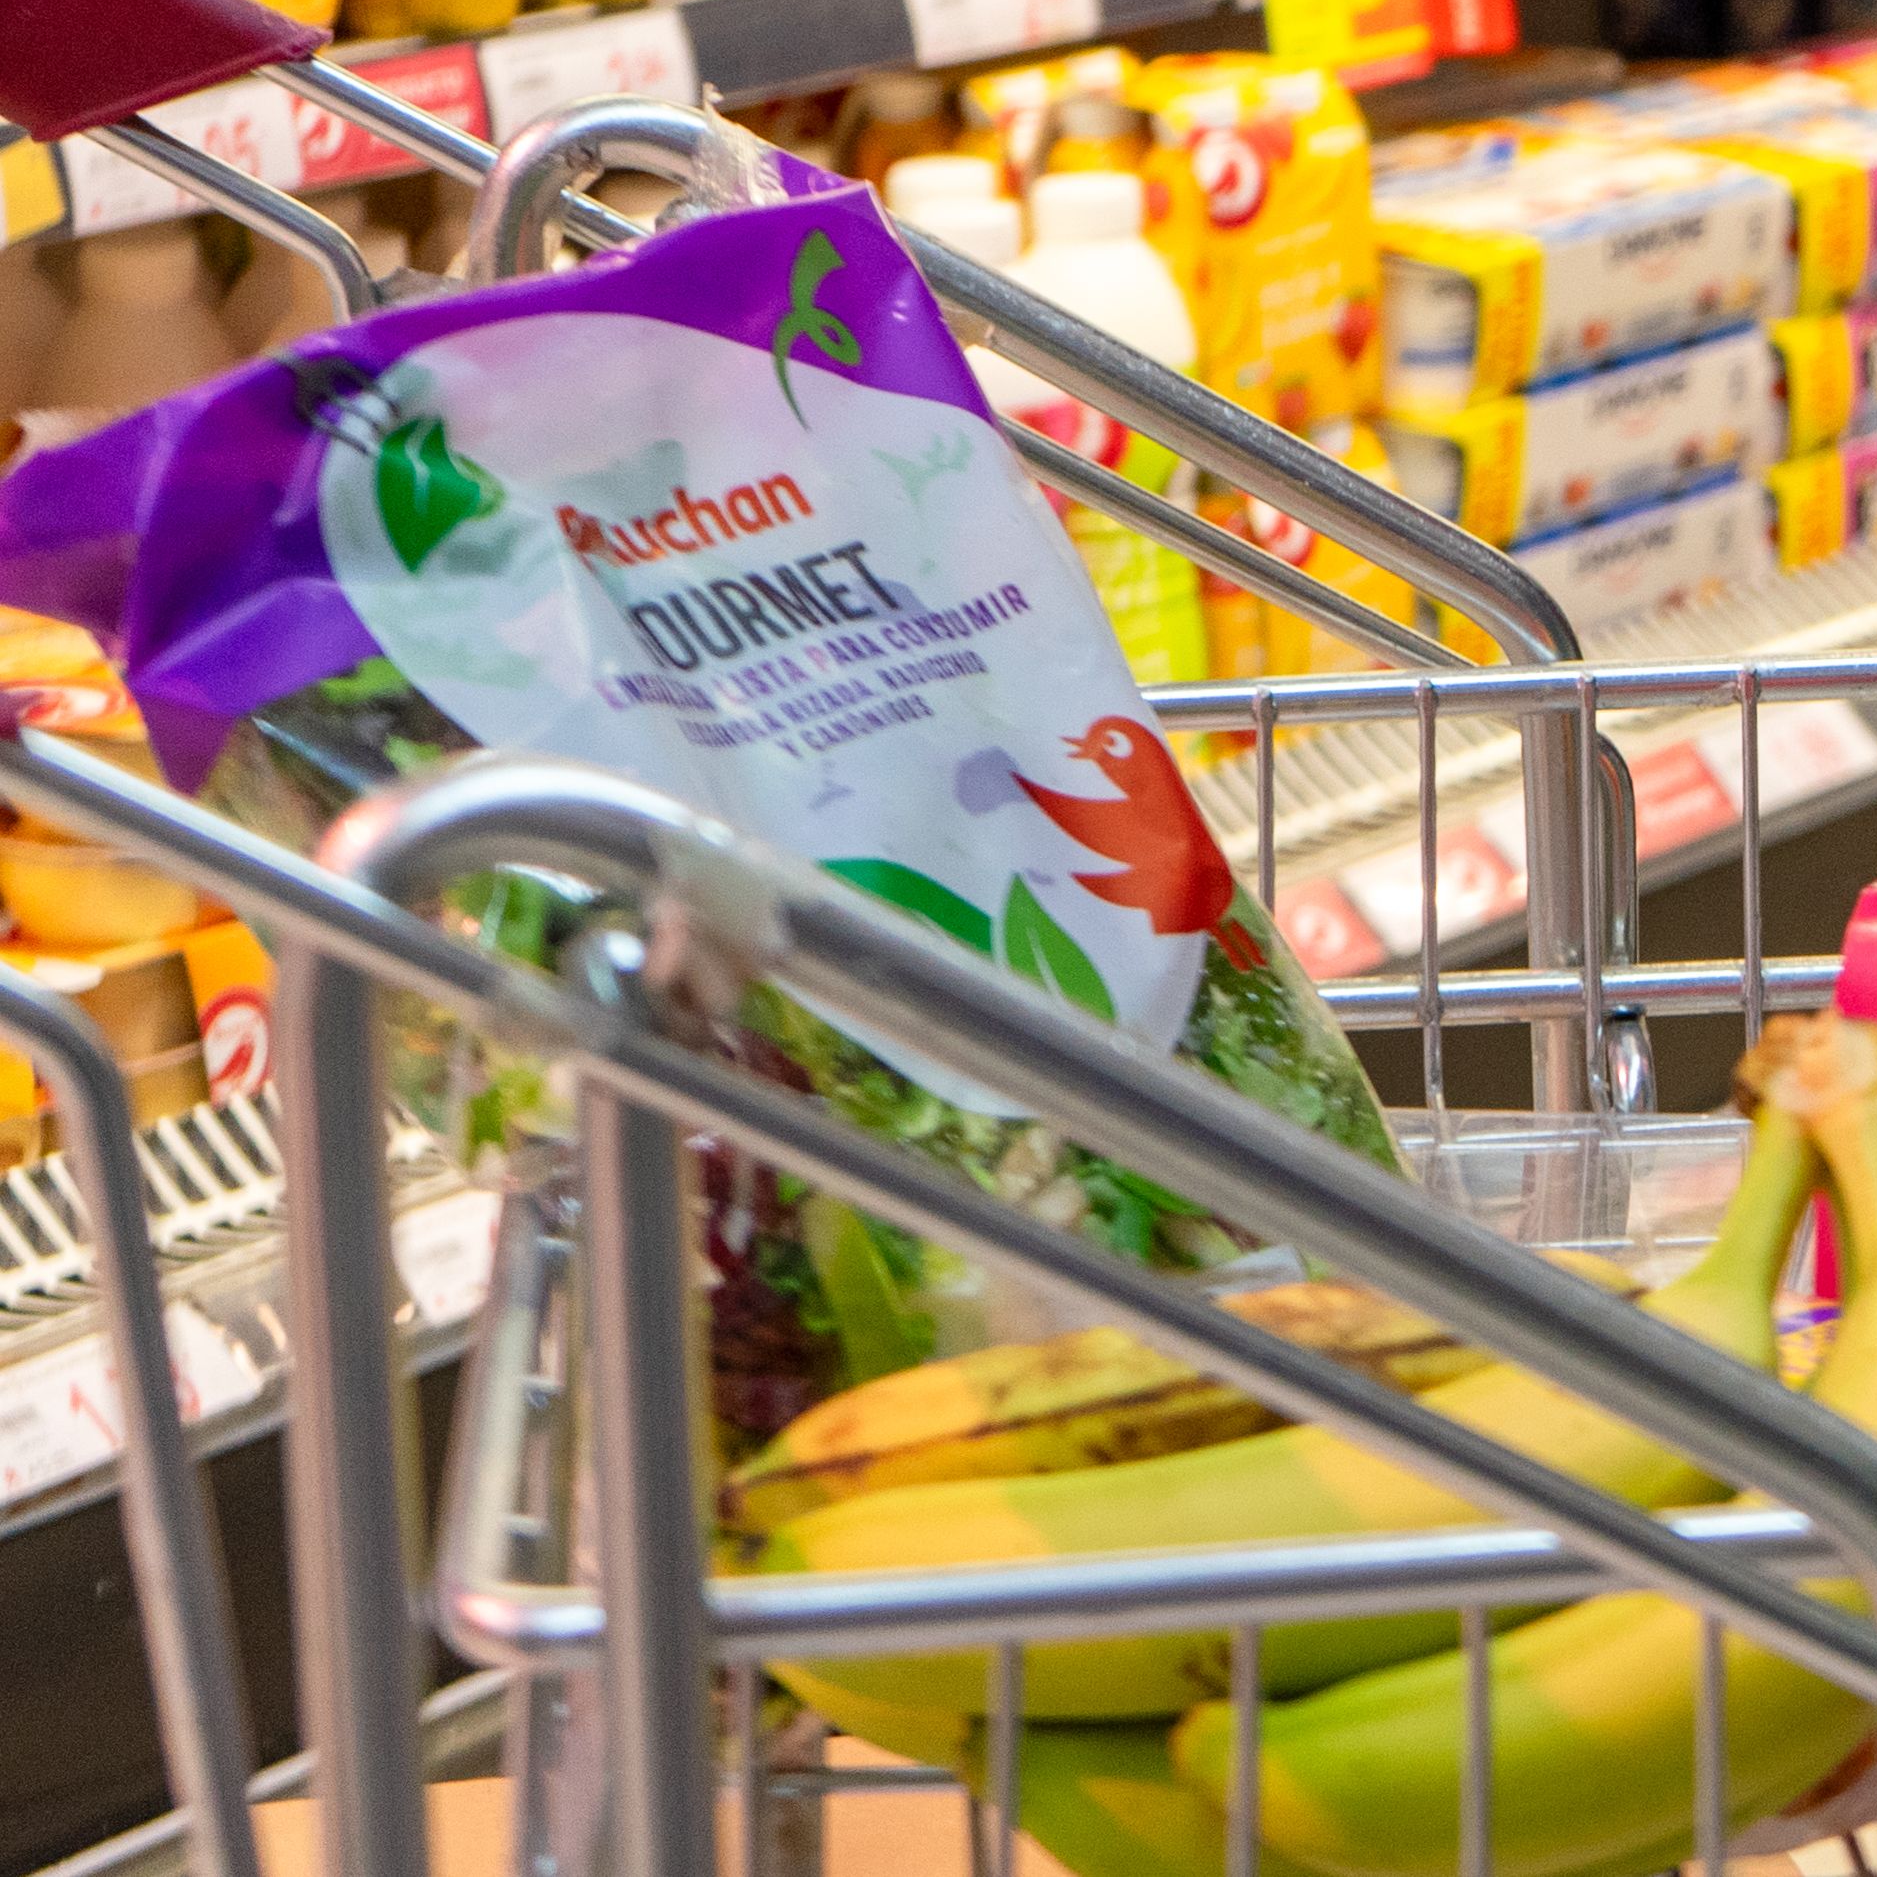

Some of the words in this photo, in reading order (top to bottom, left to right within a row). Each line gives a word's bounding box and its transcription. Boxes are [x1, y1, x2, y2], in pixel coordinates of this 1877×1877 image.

[555, 471, 816, 574] Auchan
[627, 539, 906, 673] OURMET
[879, 580, 1034, 653] CONSUMIR
